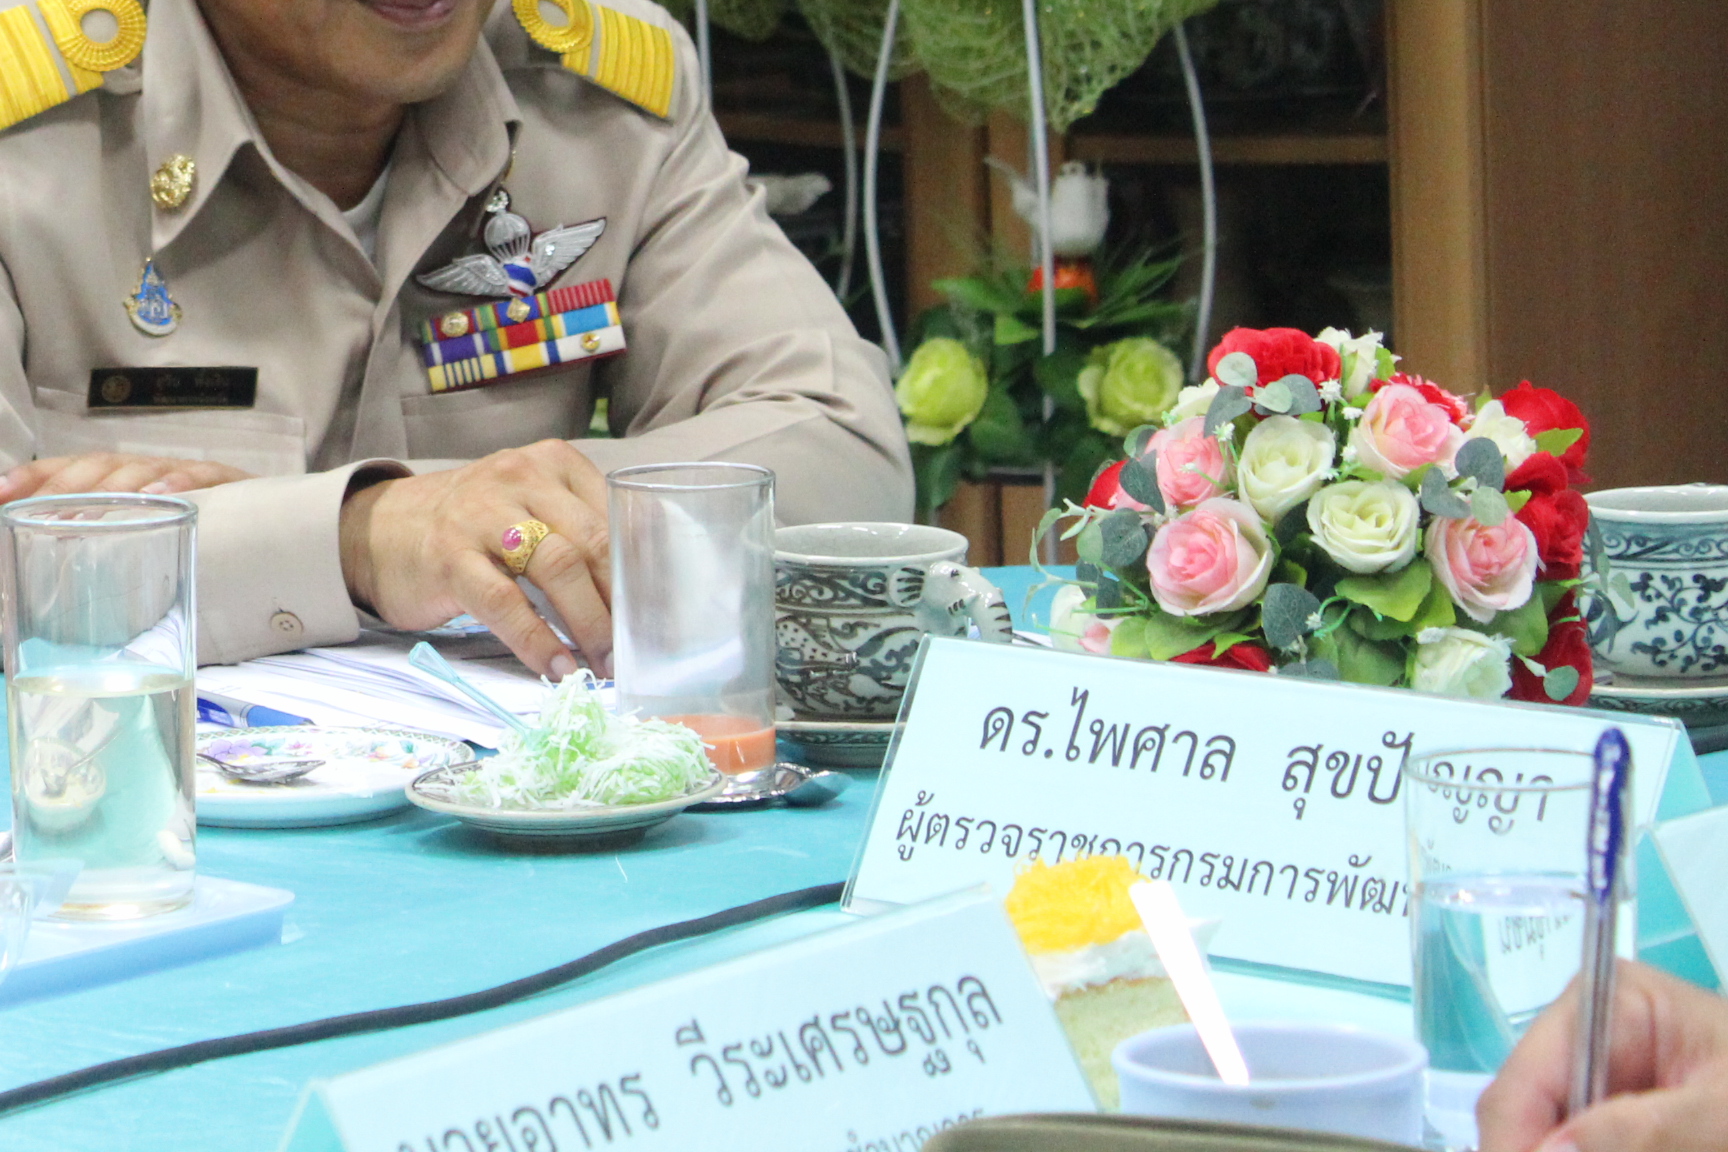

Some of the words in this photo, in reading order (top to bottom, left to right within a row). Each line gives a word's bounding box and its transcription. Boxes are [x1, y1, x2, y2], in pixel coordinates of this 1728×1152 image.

[979, 686, 1237, 783] ดร.ไพศาล
[398, 1072, 660, 1152] ยอาทร
[674, 975, 1003, 1106] วีระเศรษฐกุล
